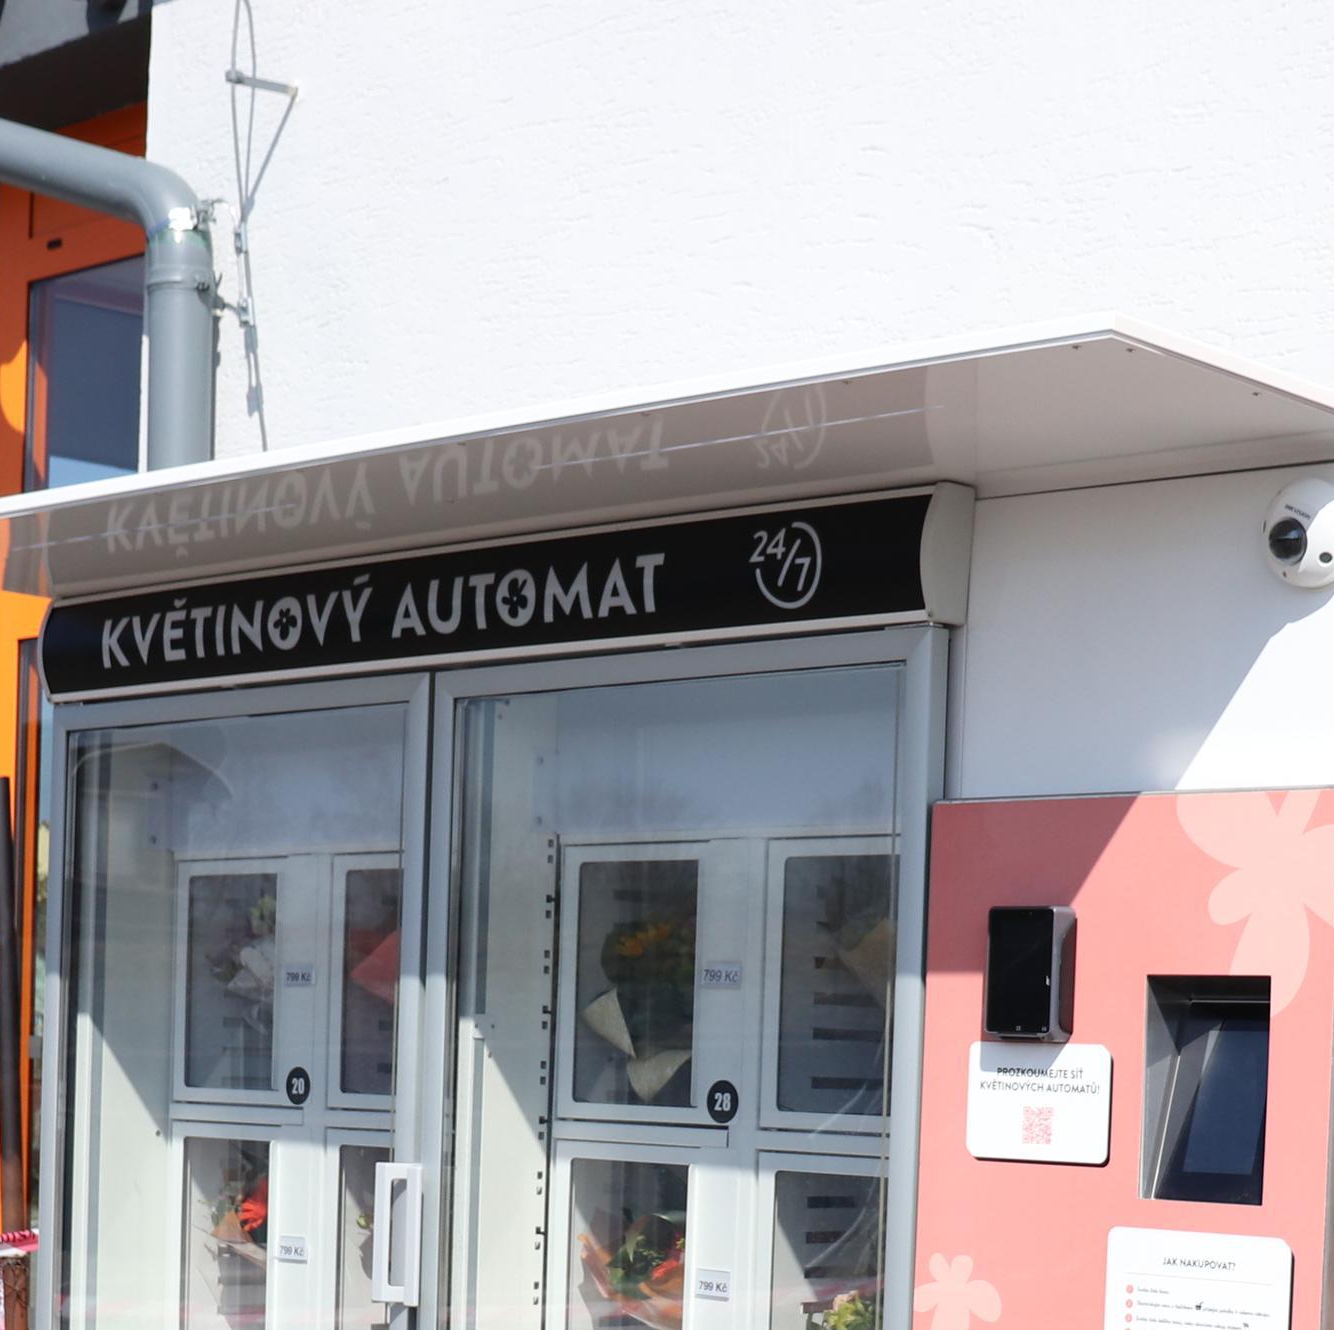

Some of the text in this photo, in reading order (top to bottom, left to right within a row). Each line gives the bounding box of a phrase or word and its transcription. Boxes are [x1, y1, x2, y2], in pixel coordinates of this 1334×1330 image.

[749, 528, 812, 592] 24/7
[101, 552, 666, 669] KVĚTINOVÝ AUTOMAT
[703, 969, 739, 983] 799 Kč
[996, 1067, 1068, 1080] PROZKOUMEJTE
[291, 1077, 305, 1095] 20
[980, 1079, 1044, 1093] KVĚTINOVÝCH
[714, 1092, 732, 1112] 28
[1163, 1256, 1236, 1271] JAK NAKUPOVAT?
[699, 1280, 714, 1292] 799
